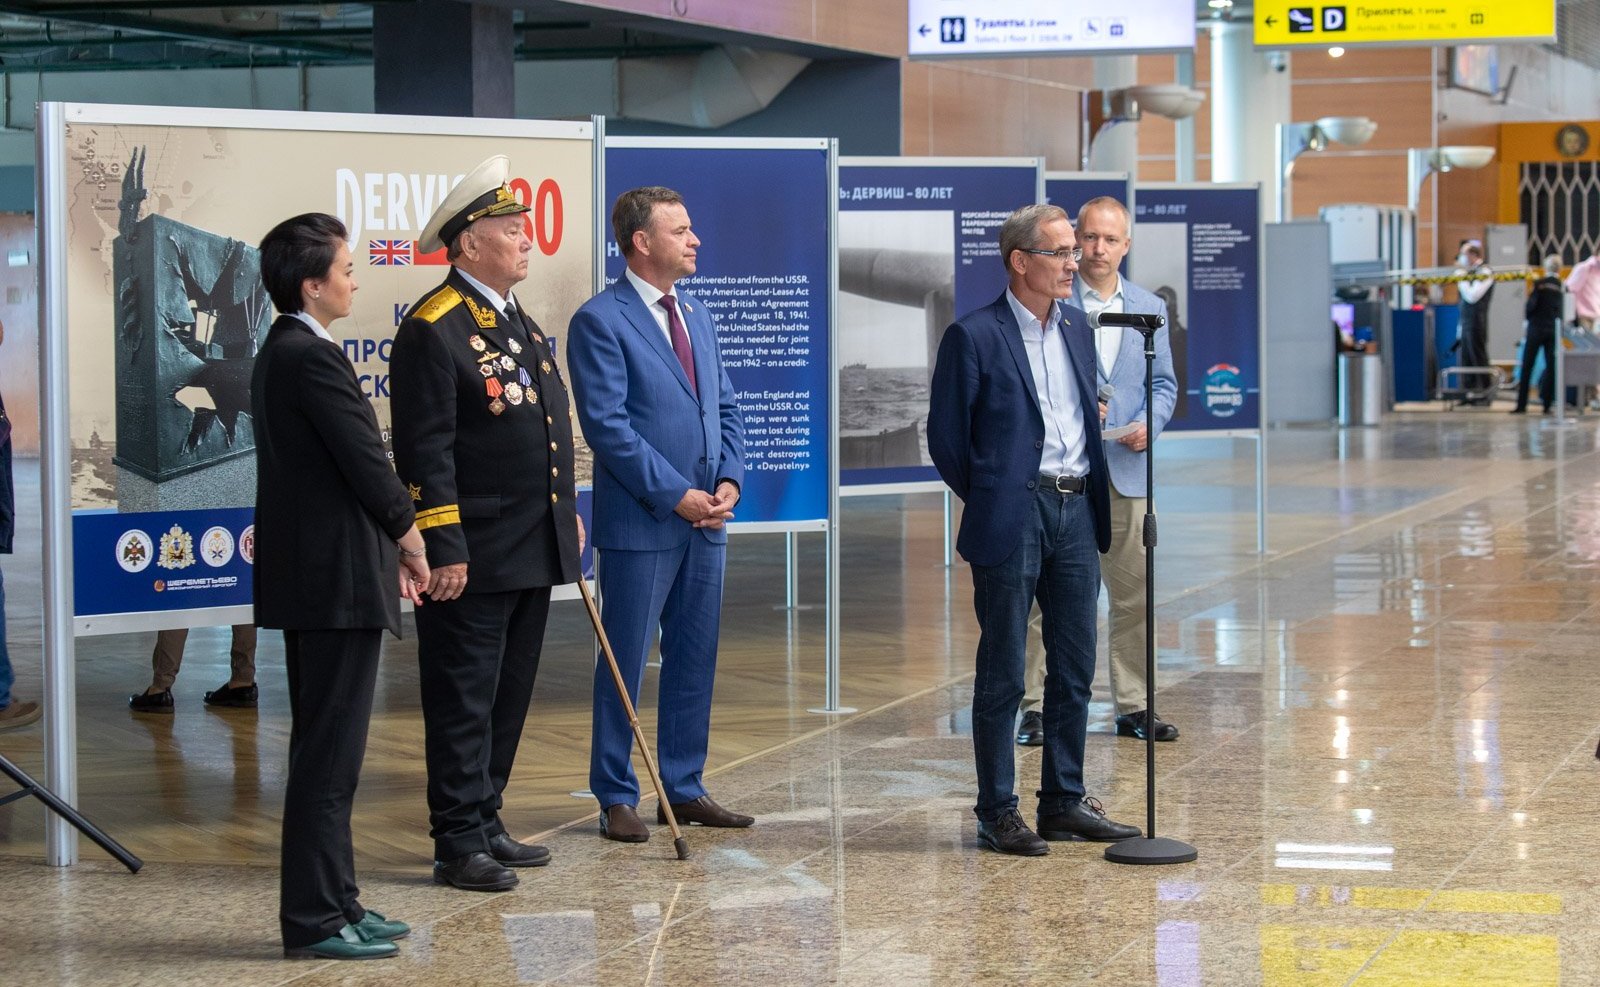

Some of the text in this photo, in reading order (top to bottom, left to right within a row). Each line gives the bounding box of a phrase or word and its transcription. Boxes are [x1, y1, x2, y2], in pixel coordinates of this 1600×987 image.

[1324, 8, 1343, 30] D
[839, 187, 850, 199] Ь:
[852, 187, 904, 200] ДЕРВИШ
[915, 187, 929, 199] 80
[930, 187, 954, 199] ЛЕТ
[691, 275, 727, 284] delivered
[728, 276, 737, 284] to
[737, 276, 752, 285] and
[752, 275, 771, 284] from
[771, 275, 785, 284] the
[785, 275, 810, 284] USSR.
[698, 287, 711, 296] the
[712, 287, 749, 296] American
[750, 287, 794, 296] Lend-Lease
[795, 287, 809, 296] Act
[703, 299, 809, 310] Soviet-British «Agreement
[728, 311, 738, 320] of
[740, 311, 770, 321] August
[774, 311, 786, 321] 18,
[789, 311, 810, 320] 1941.
[716, 323, 810, 332] the United States had the
[746, 335, 775, 343] needed
[777, 335, 789, 343] for
[790, 335, 809, 345] joint
[721, 347, 810, 357] entering the war, these
[721, 359, 742, 368] since
[742, 359, 761, 368] 1942
[783, 359, 809, 367] credit-
[743, 390, 762, 399] from
[763, 391, 794, 400] England
[795, 390, 810, 399] and
[737, 402, 809, 411] from the USSR. Out
[744, 414, 765, 424] ships
[791, 414, 810, 422] sunk
[768, 426, 784, 435] lost
[785, 426, 810, 436] during
[754, 438, 769, 447] and
[770, 438, 810, 446] «Trinidad»
[744, 450, 810, 460] oviet destroyers
[757, 461, 810, 472] «Deyatelny»
[167, 576, 237, 587] ШЕРЕМЕТЬЕВО
